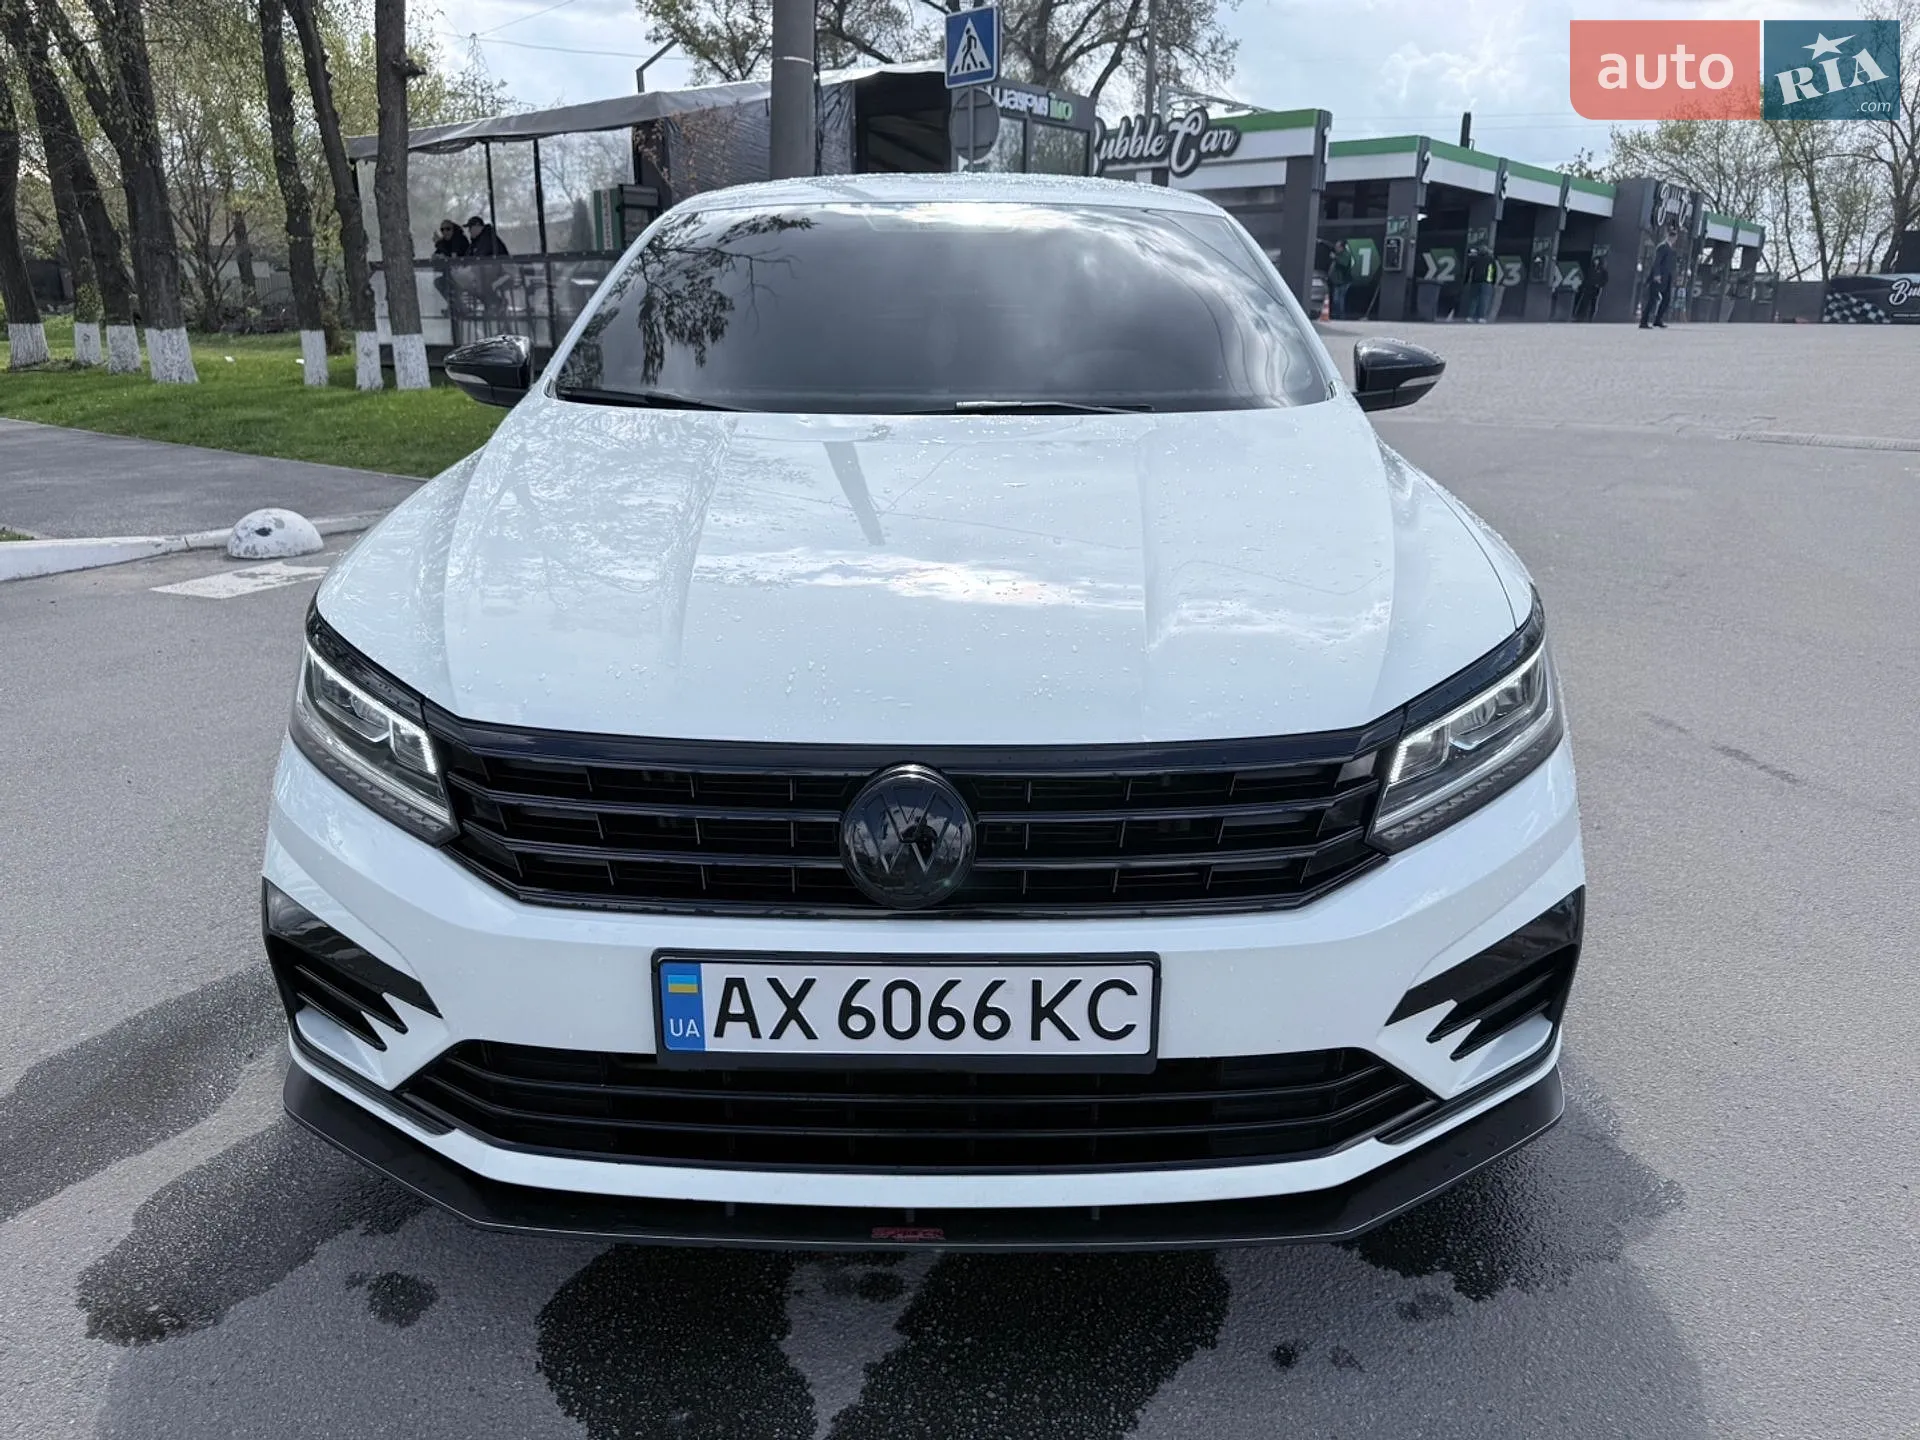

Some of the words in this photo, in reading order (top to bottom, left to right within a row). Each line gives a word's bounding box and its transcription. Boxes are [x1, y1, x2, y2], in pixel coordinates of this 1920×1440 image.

[1168, 108, 1237, 174] Car
[1358, 247, 1372, 277] 1
[1436, 256, 1456, 281] 2
[1502, 262, 1521, 286] 3
[1562, 267, 1583, 292] 4
[713, 977, 819, 1040] AX
[837, 978, 1012, 1041] 6066
[1031, 978, 1139, 1042] KC
[669, 1018, 700, 1039] UA
